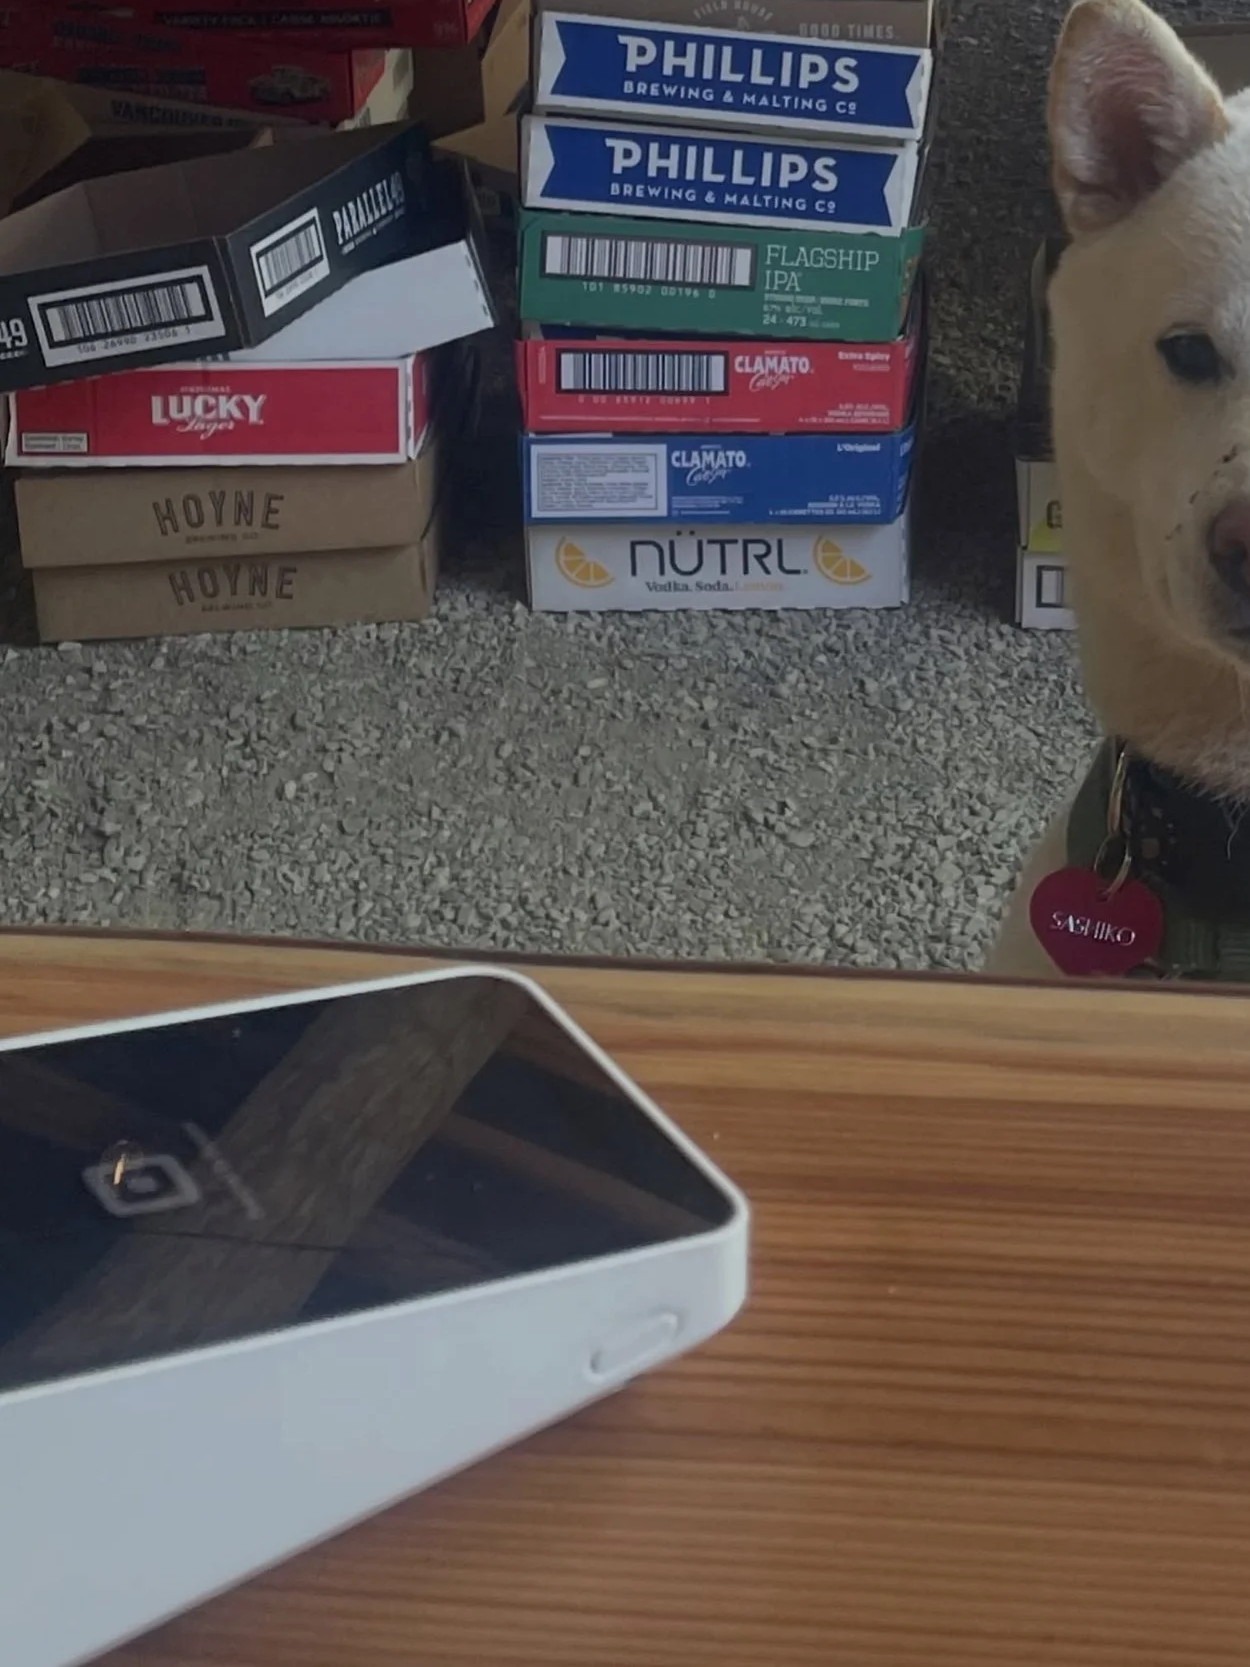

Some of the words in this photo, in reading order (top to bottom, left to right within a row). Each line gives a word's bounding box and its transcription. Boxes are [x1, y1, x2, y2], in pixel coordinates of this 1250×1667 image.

[847, 23, 895, 39] TIMES
[617, 34, 860, 94] PHILLIPS
[622, 80, 715, 103] BREWING
[723, 89, 734, 104] &
[742, 92, 828, 112] MALTING
[605, 138, 839, 193] PHILLIPS
[332, 178, 395, 246] PARALLEL
[609, 182, 696, 202] BREWING
[705, 190, 716, 203] &
[723, 193, 807, 211] MALTING
[764, 244, 880, 272] FLAGSHIP
[764, 269, 802, 292] IPA
[734, 355, 811, 374] CLAMATO
[151, 394, 268, 426] LUCKY
[175, 416, 236, 441] Lager
[671, 450, 747, 468] CLAMATO
[152, 490, 285, 537] HOYNE
[168, 562, 297, 607] HOYNE
[1049, 909, 1137, 947] SASHIKO
